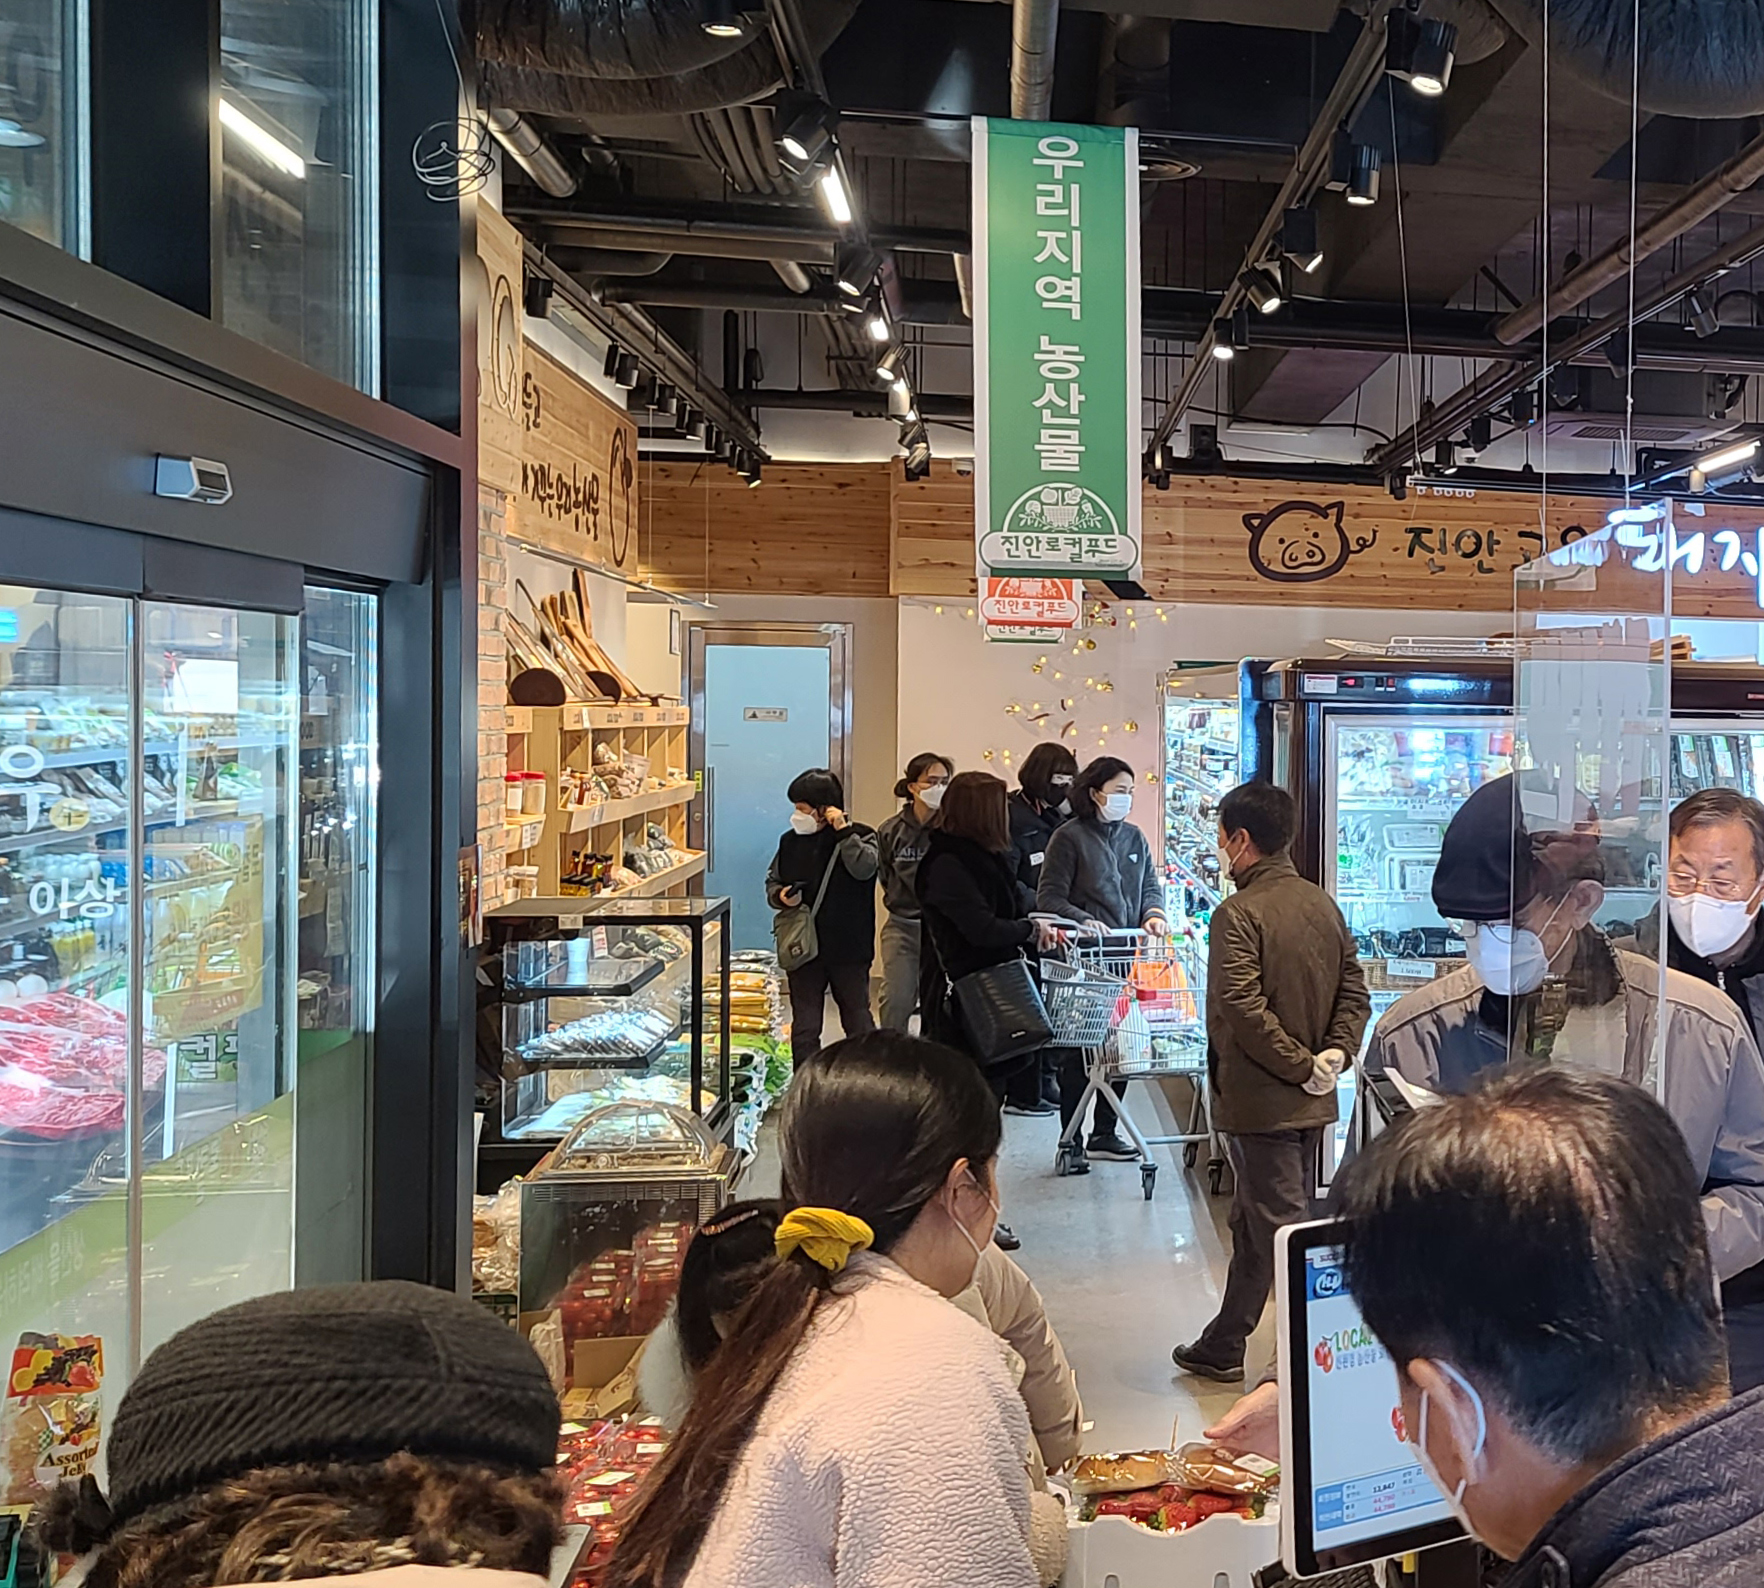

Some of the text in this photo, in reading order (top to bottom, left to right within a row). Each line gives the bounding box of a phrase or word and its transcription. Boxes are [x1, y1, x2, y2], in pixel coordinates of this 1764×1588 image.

[1031, 134, 1086, 472] 우리지역 농산물
[1000, 534, 1121, 563] 진안로컬푸드
[1405, 526, 1501, 574] 진안
[993, 599, 1069, 618] 진안로컬푸드
[29, 877, 122, 920] 이상
[39, 1440, 100, 1468] Assorted
